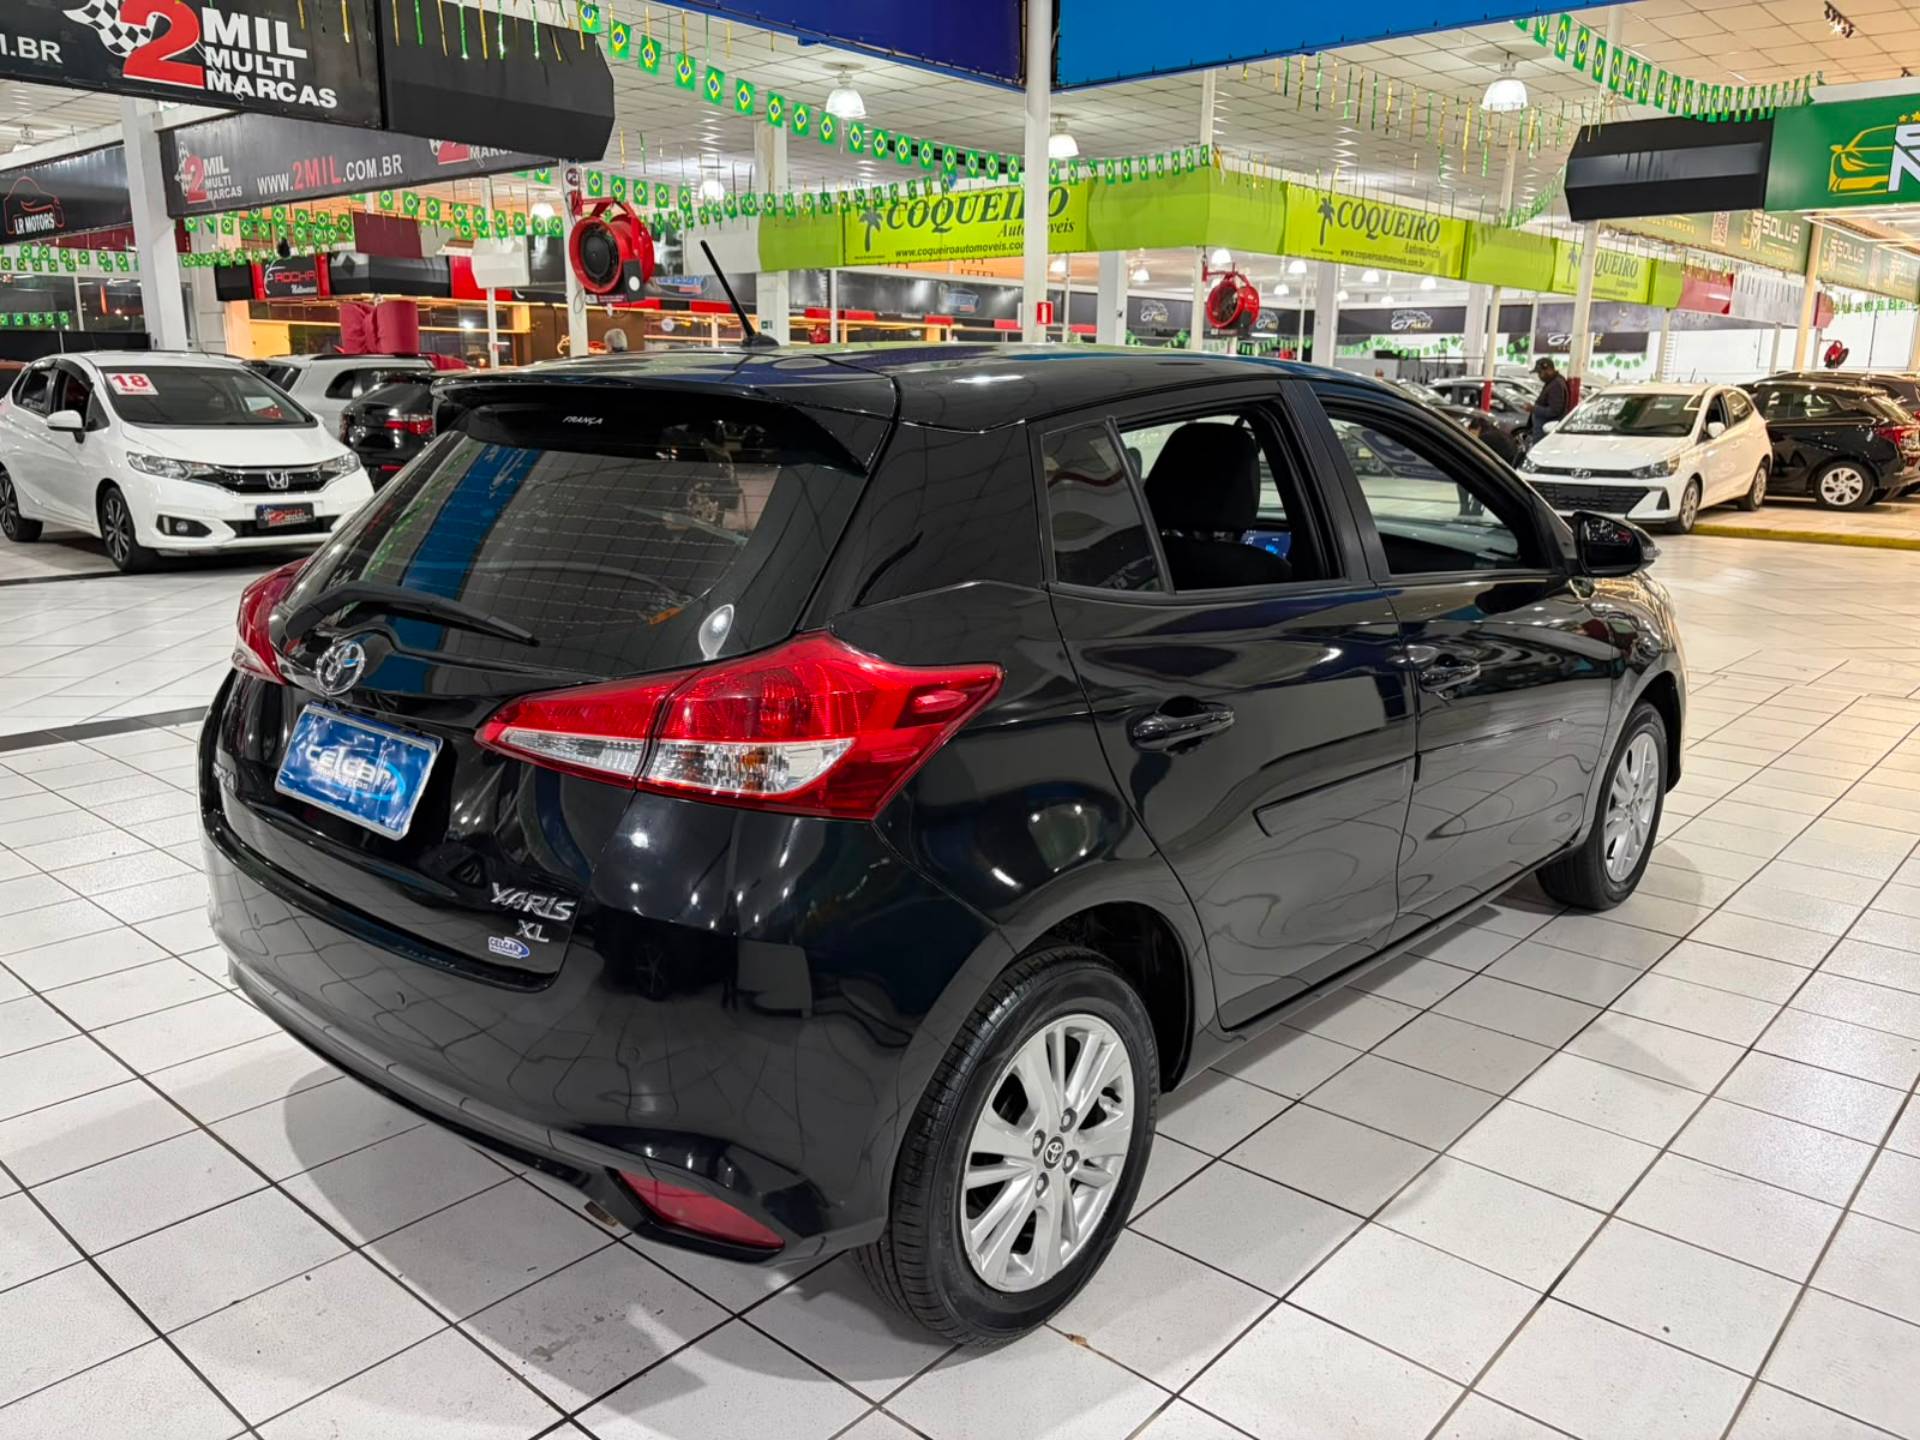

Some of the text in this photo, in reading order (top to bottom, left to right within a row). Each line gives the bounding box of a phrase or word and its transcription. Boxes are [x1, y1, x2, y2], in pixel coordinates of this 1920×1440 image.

[0, 34, 64, 64] .BR
[119, 0, 308, 89] 2 MIL
[205, 46, 296, 80] MULTI
[206, 70, 338, 109] MARCAS
[203, 155, 230, 175] MIL
[257, 153, 404, 196] WWW.2MIL.COM.BR
[206, 175, 232, 189] MULTI
[207, 184, 243, 201] MARCAS
[15, 212, 55, 235] LR MOTORS
[886, 186, 1069, 234] COQUEIO
[1336, 200, 1441, 244] COQUEIRO
[1594, 250, 1640, 278] QUEIRO
[112, 375, 149, 388] 18
[491, 882, 577, 921] YARIS
[515, 919, 550, 943] XL
